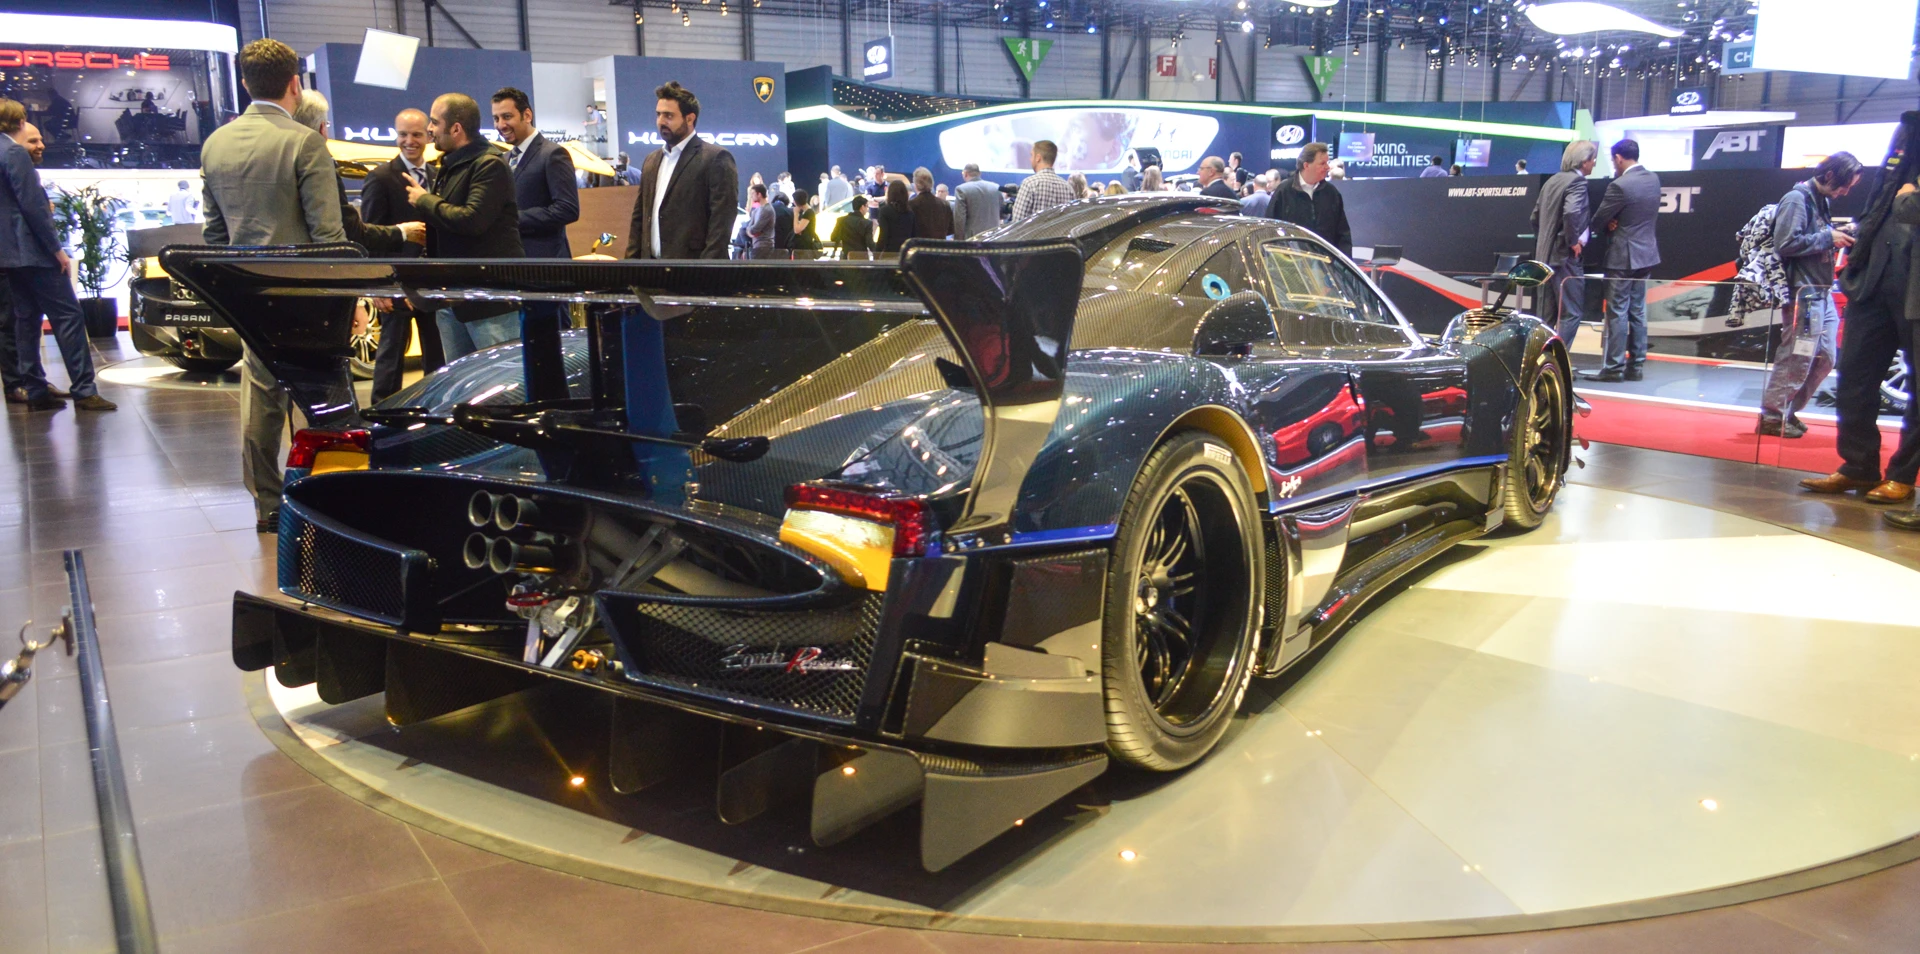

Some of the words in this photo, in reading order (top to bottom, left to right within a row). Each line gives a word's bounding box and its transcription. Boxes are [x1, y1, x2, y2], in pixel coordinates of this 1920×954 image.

[0, 49, 170, 71] ORSCHE
[1162, 56, 1174, 72] F
[1734, 51, 1753, 63] CH
[628, 131, 780, 147] HUACAN
[1701, 130, 1767, 160] ABT
[1372, 142, 1409, 155] KING.
[1348, 154, 1433, 167] SIBILITIES.
[1448, 186, 1528, 197] WWW.ABT-SPORTSLINE.COM
[1658, 186, 1701, 213] BT
[164, 314, 211, 322] PAGANI
